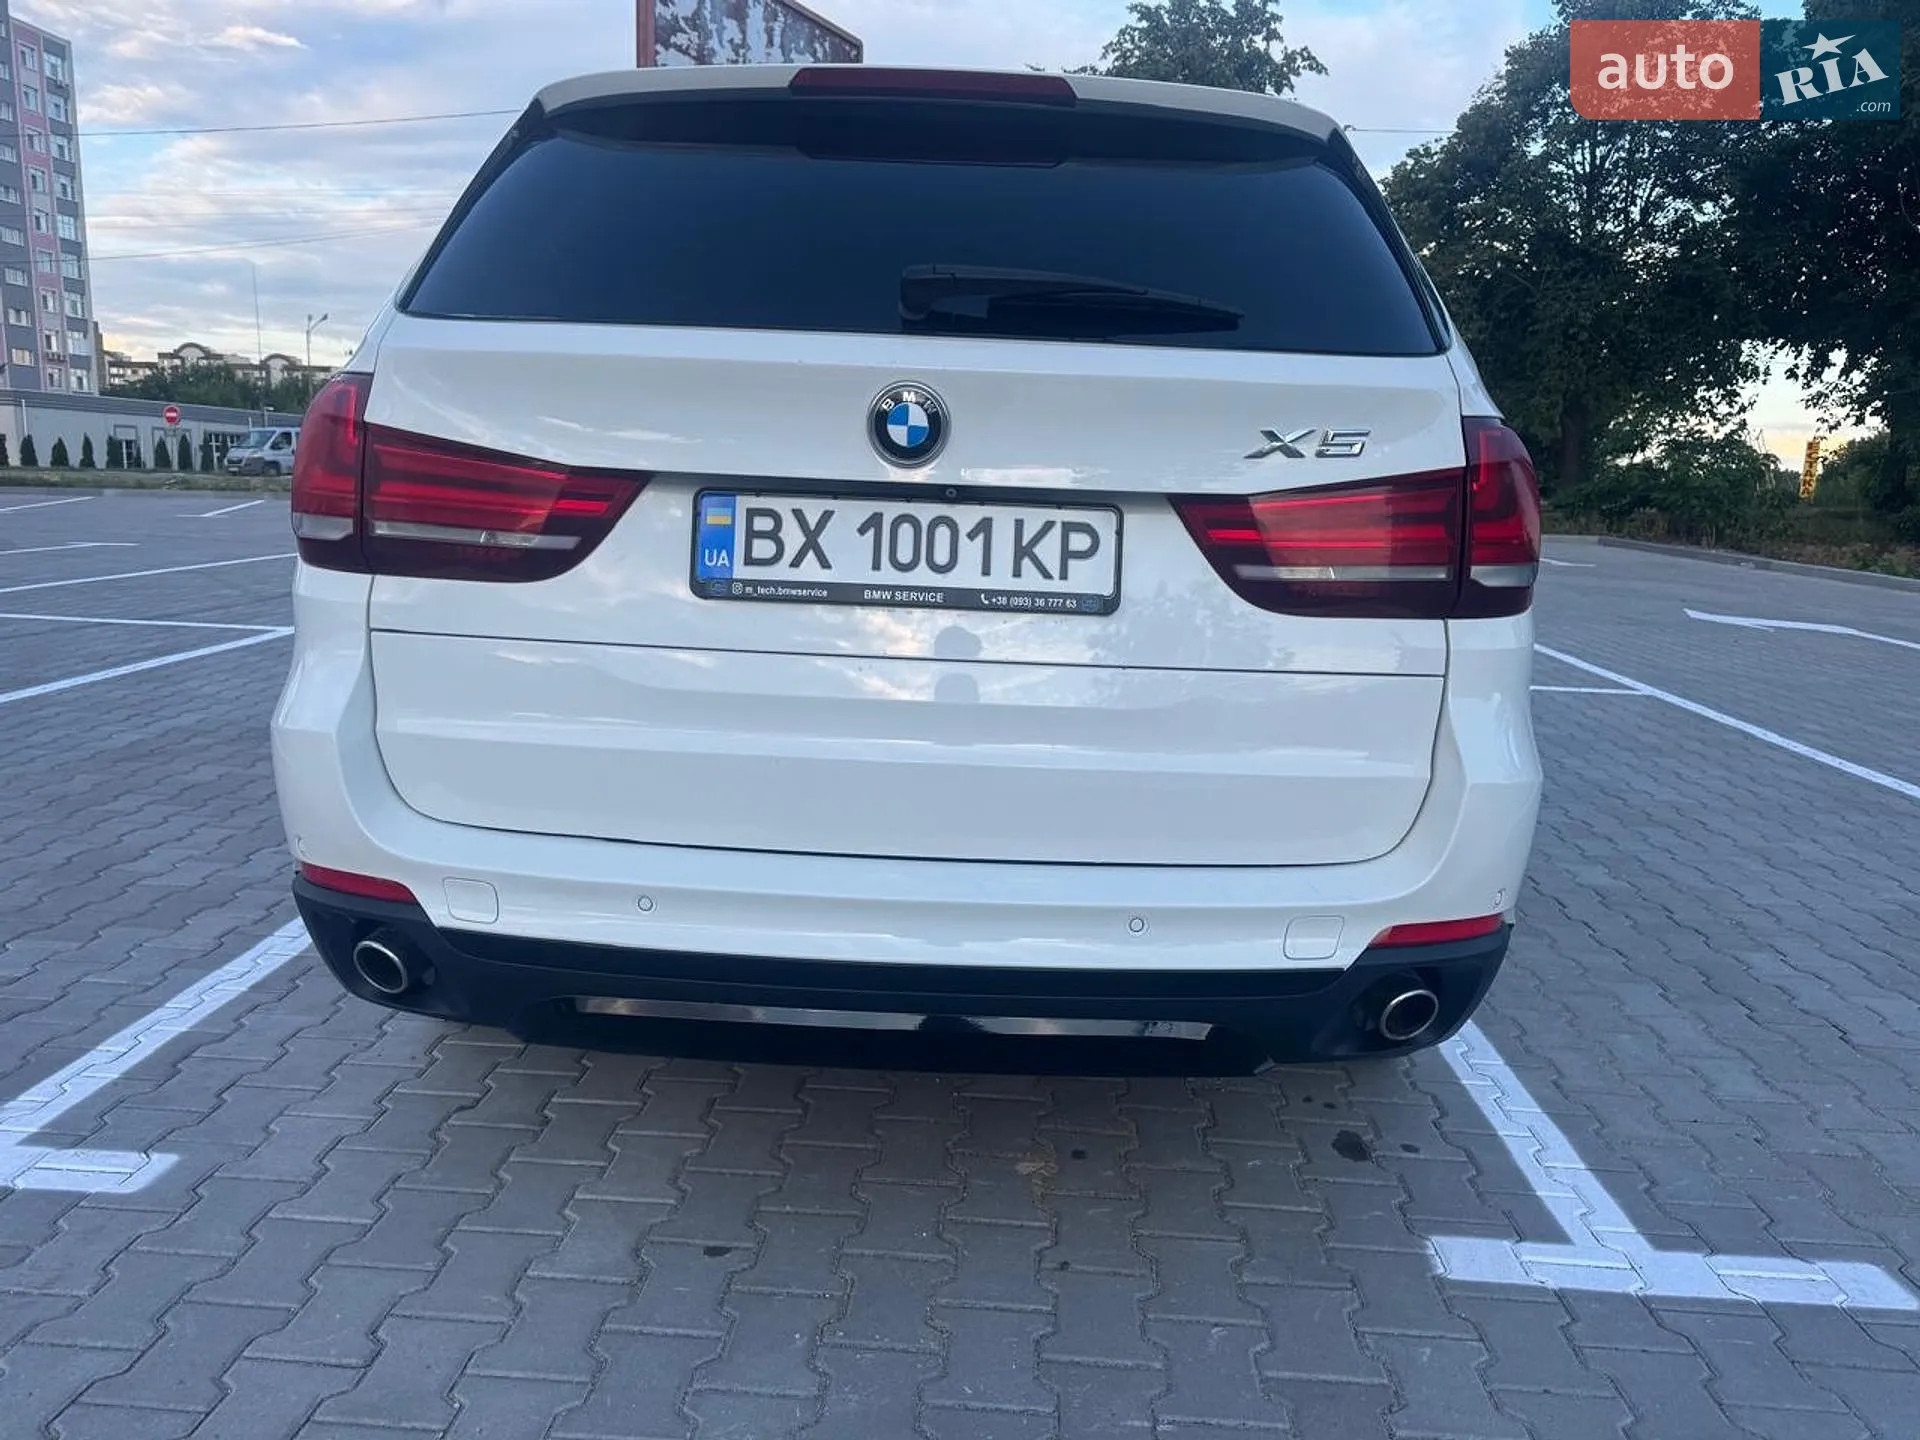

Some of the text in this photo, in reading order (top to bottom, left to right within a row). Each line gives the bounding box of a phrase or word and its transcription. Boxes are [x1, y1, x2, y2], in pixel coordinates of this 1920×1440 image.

[881, 391, 937, 414] BMW
[1243, 427, 1372, 459] X5
[743, 507, 1101, 581] BX 1001 KP
[704, 547, 730, 568] UA
[863, 589, 945, 603] BMW SERVICE
[1047, 598, 1064, 607] 777
